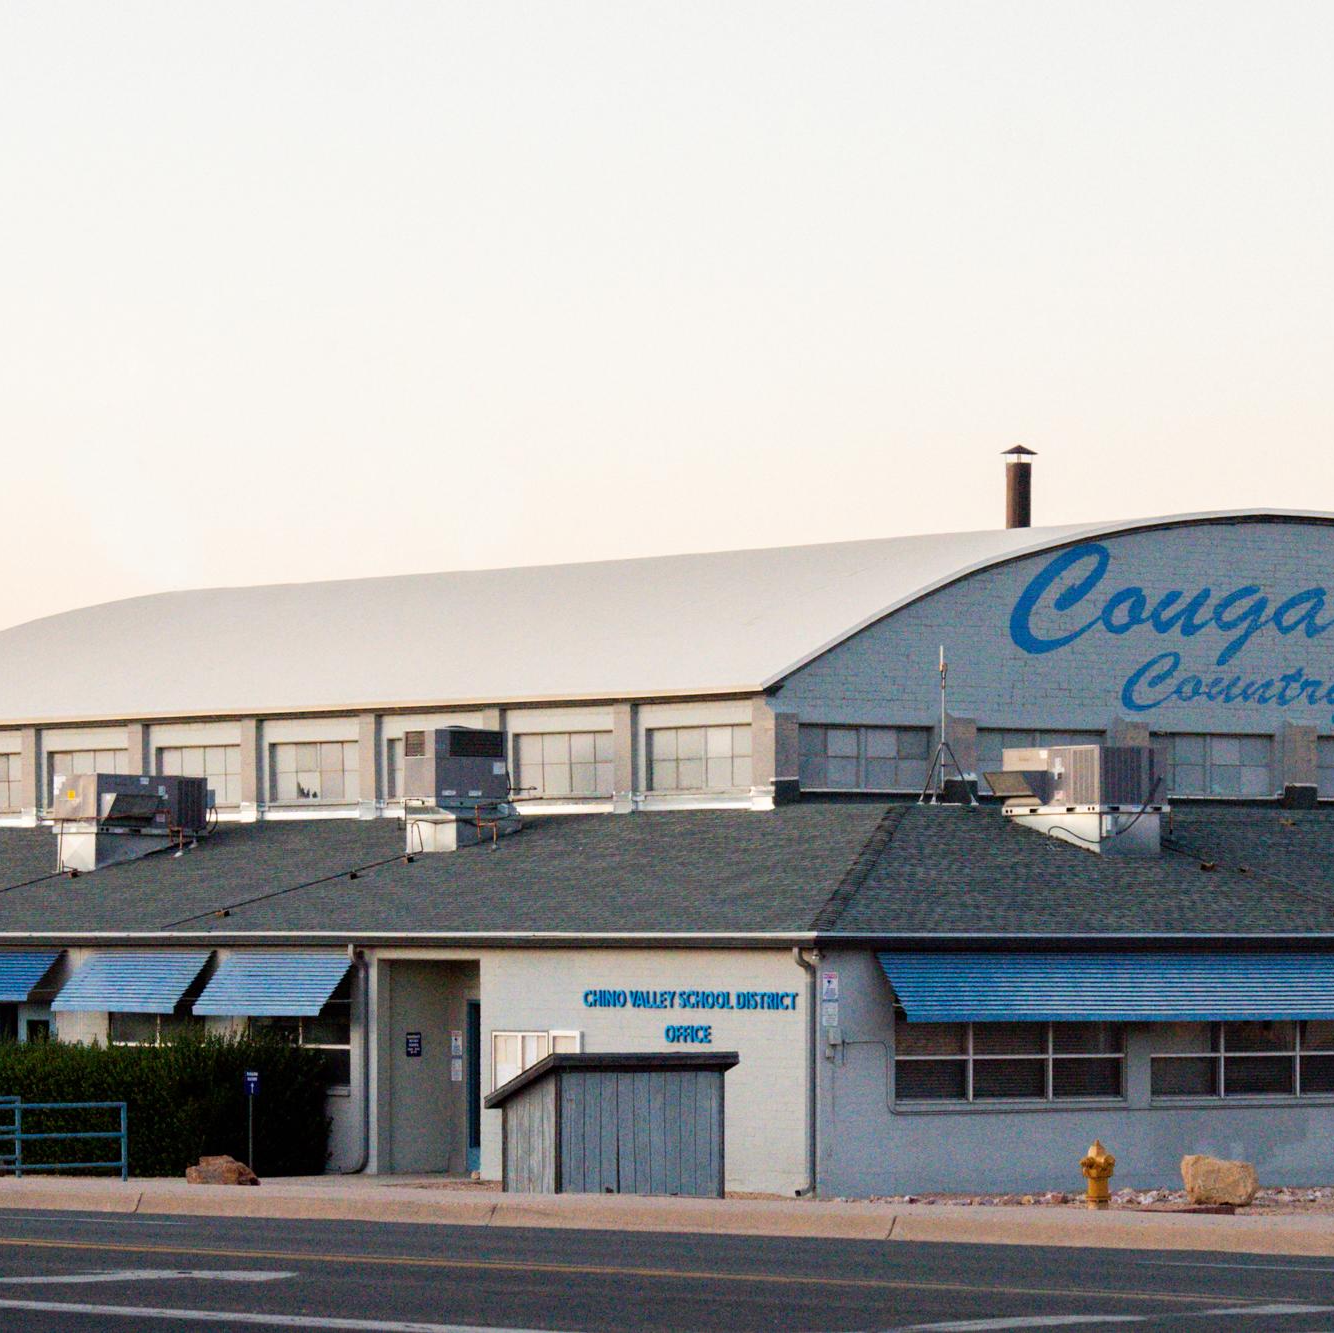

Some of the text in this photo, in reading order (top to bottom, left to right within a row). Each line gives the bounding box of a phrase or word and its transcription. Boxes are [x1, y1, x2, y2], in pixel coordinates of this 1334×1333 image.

[583, 989, 798, 1011] CHINO VALLEY SCHOOL DISTRICT
[664, 1025, 712, 1044] OFFICE
